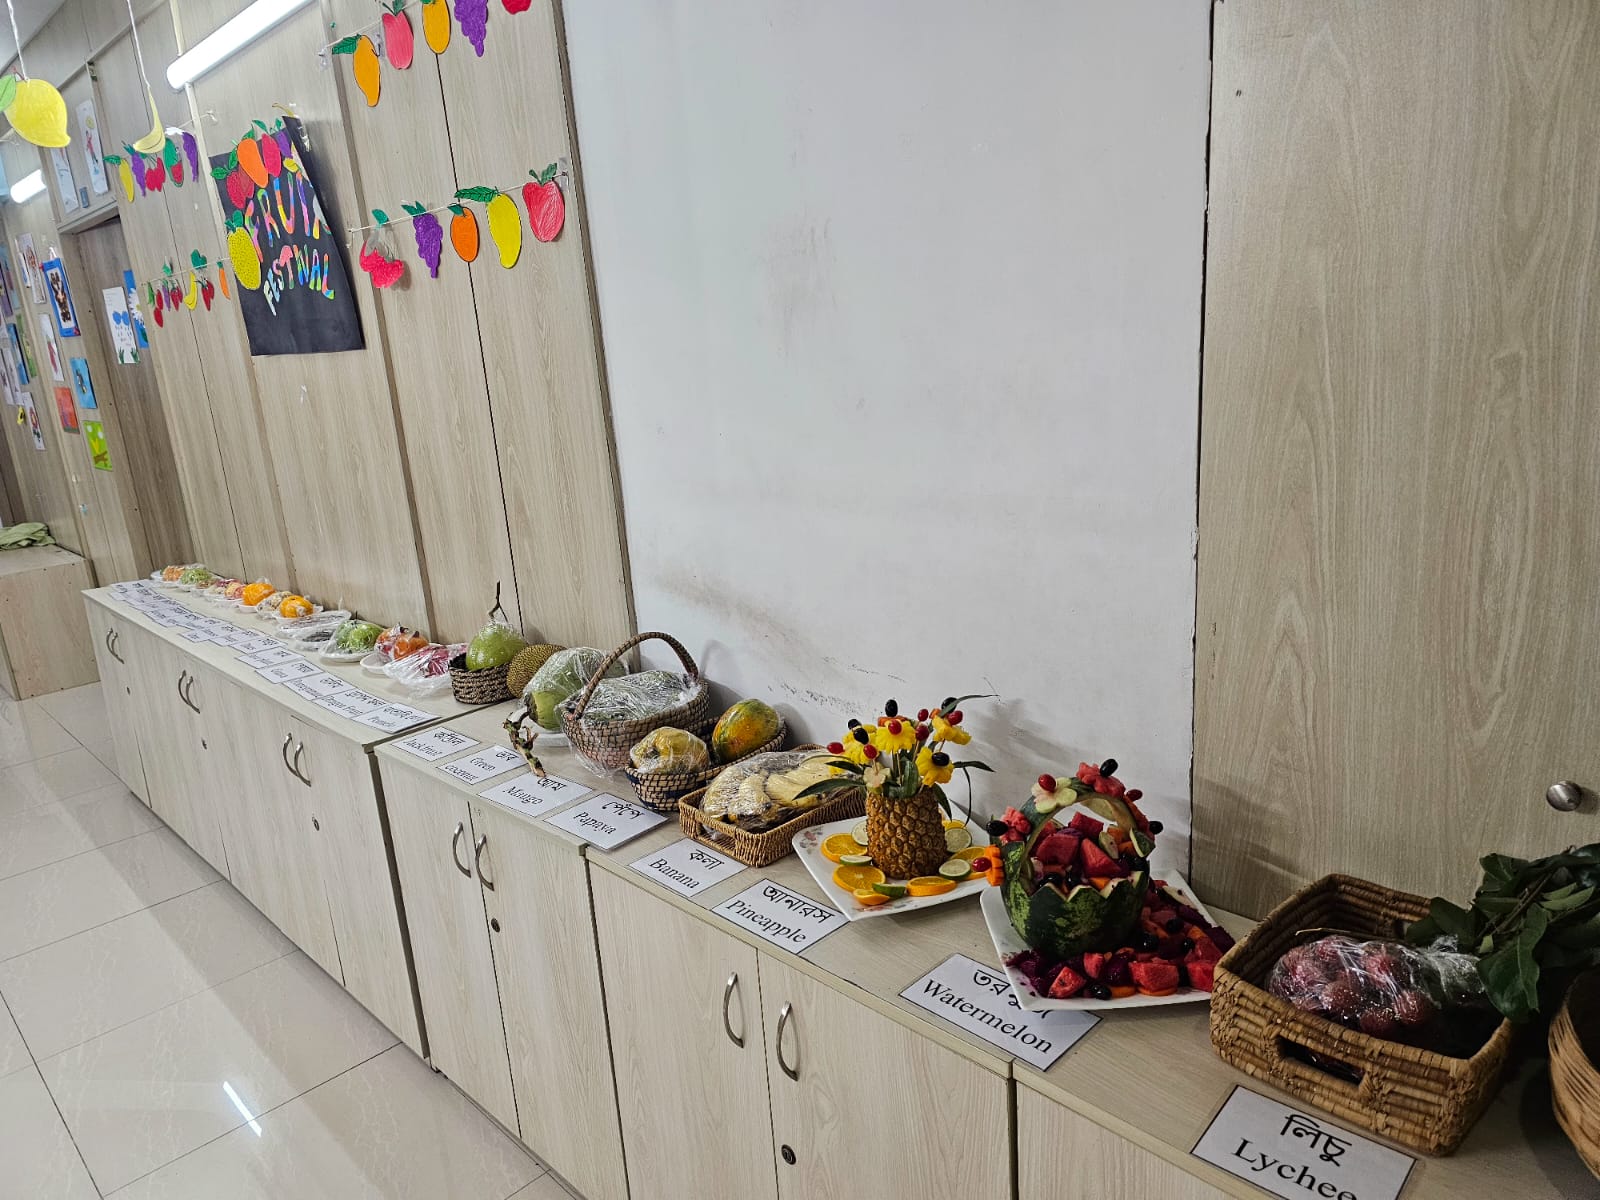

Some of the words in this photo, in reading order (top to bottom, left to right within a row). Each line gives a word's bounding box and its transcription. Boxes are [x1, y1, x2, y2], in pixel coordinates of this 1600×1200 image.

[470, 757, 496, 772] Green
[502, 786, 543, 805] Mango
[573, 811, 617, 835] Papaya
[649, 858, 701, 889] Banana
[689, 849, 724, 870] কলা
[763, 885, 835, 924] আনারস
[726, 900, 807, 943] Pineapple
[923, 979, 1053, 1054] Watermelon
[1280, 1114, 1352, 1167] লিচু
